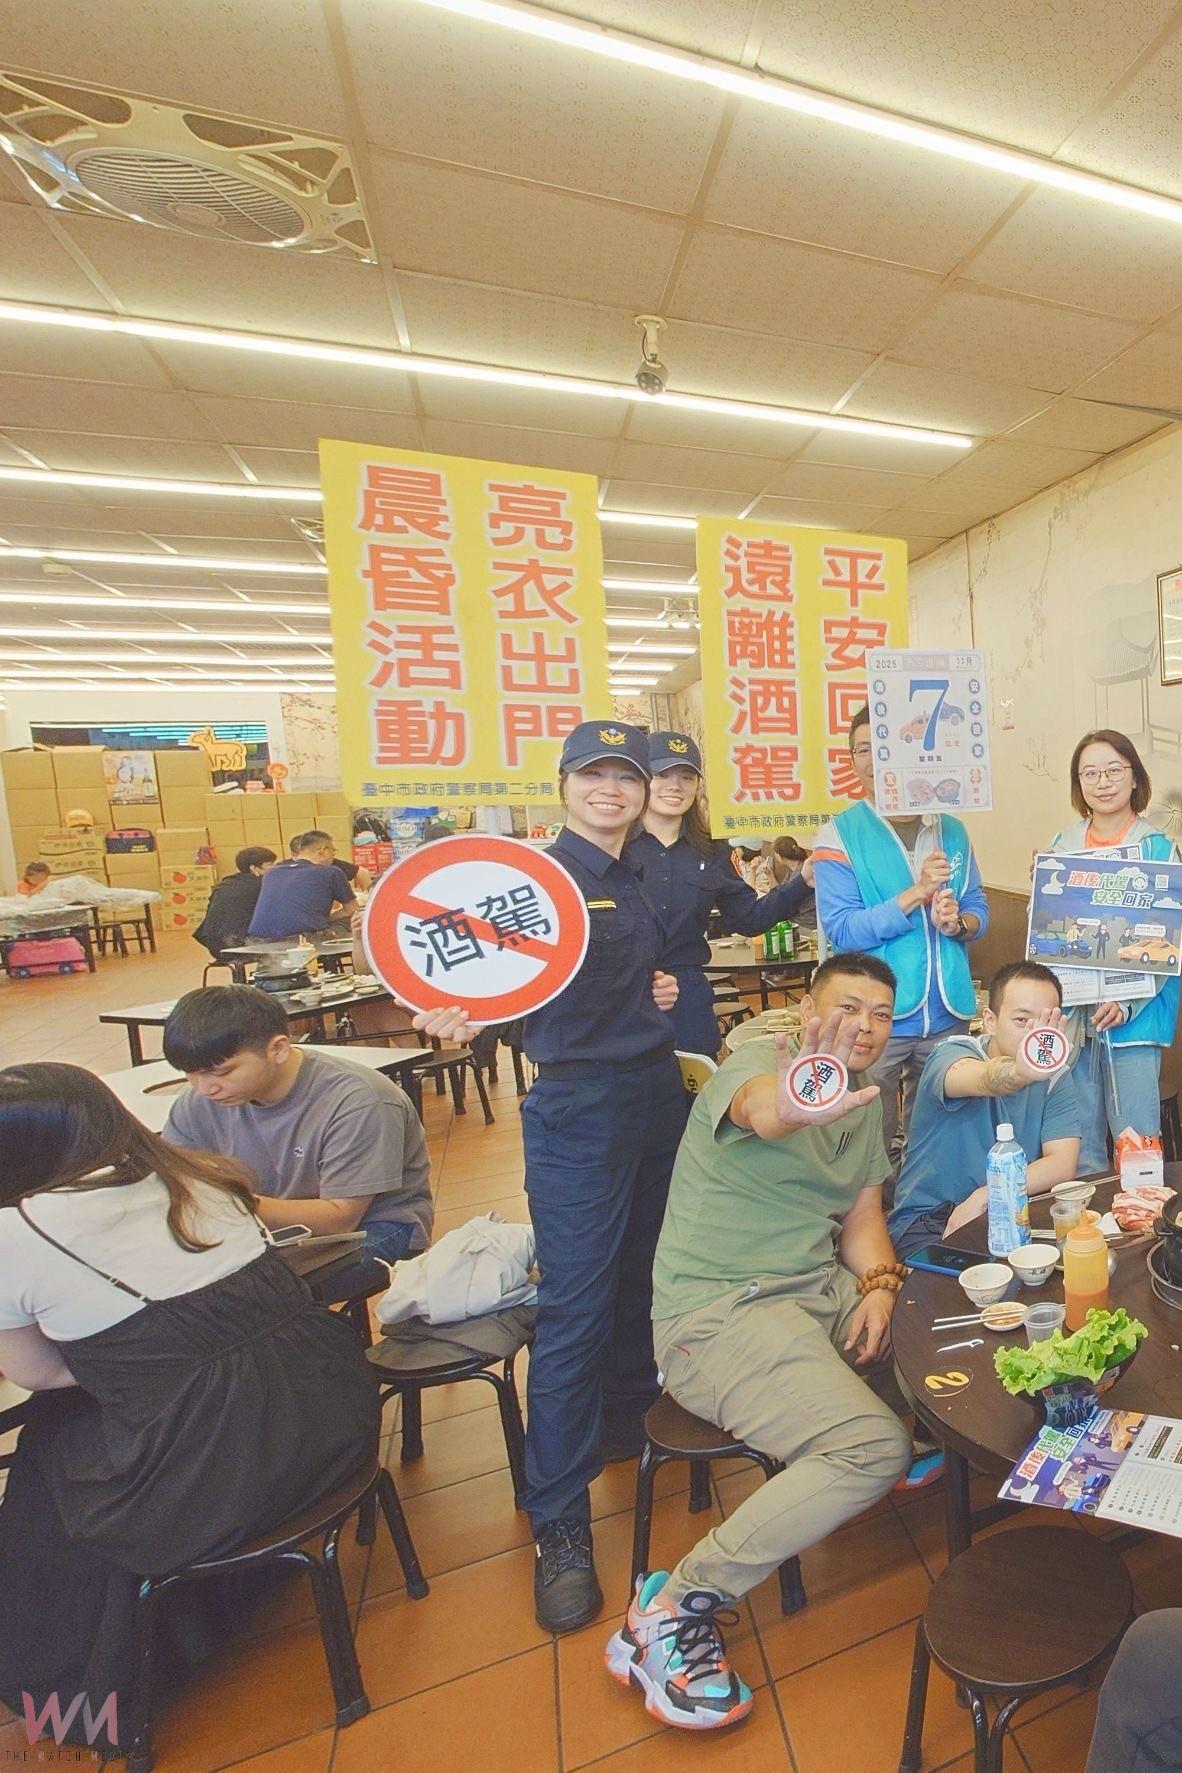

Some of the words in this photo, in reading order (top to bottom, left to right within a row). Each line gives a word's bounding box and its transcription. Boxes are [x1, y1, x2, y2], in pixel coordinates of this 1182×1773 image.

[358, 464, 467, 767] 晨昏活動
[487, 482, 582, 768] 亮衣出門
[723, 534, 801, 803] 遠離酒駕
[822, 546, 889, 801] 平安回家
[875, 659, 898, 670] 2025
[909, 679, 950, 752] 7
[361, 781, 555, 798] 臺中市政府警察局第二分局
[1067, 870, 1130, 890] 酒後代駕
[1091, 889, 1153, 909] 安全回家
[403, 883, 552, 978] 酒駕
[1036, 1033, 1056, 1066] 酒駕
[798, 1060, 836, 1103] 酒駕
